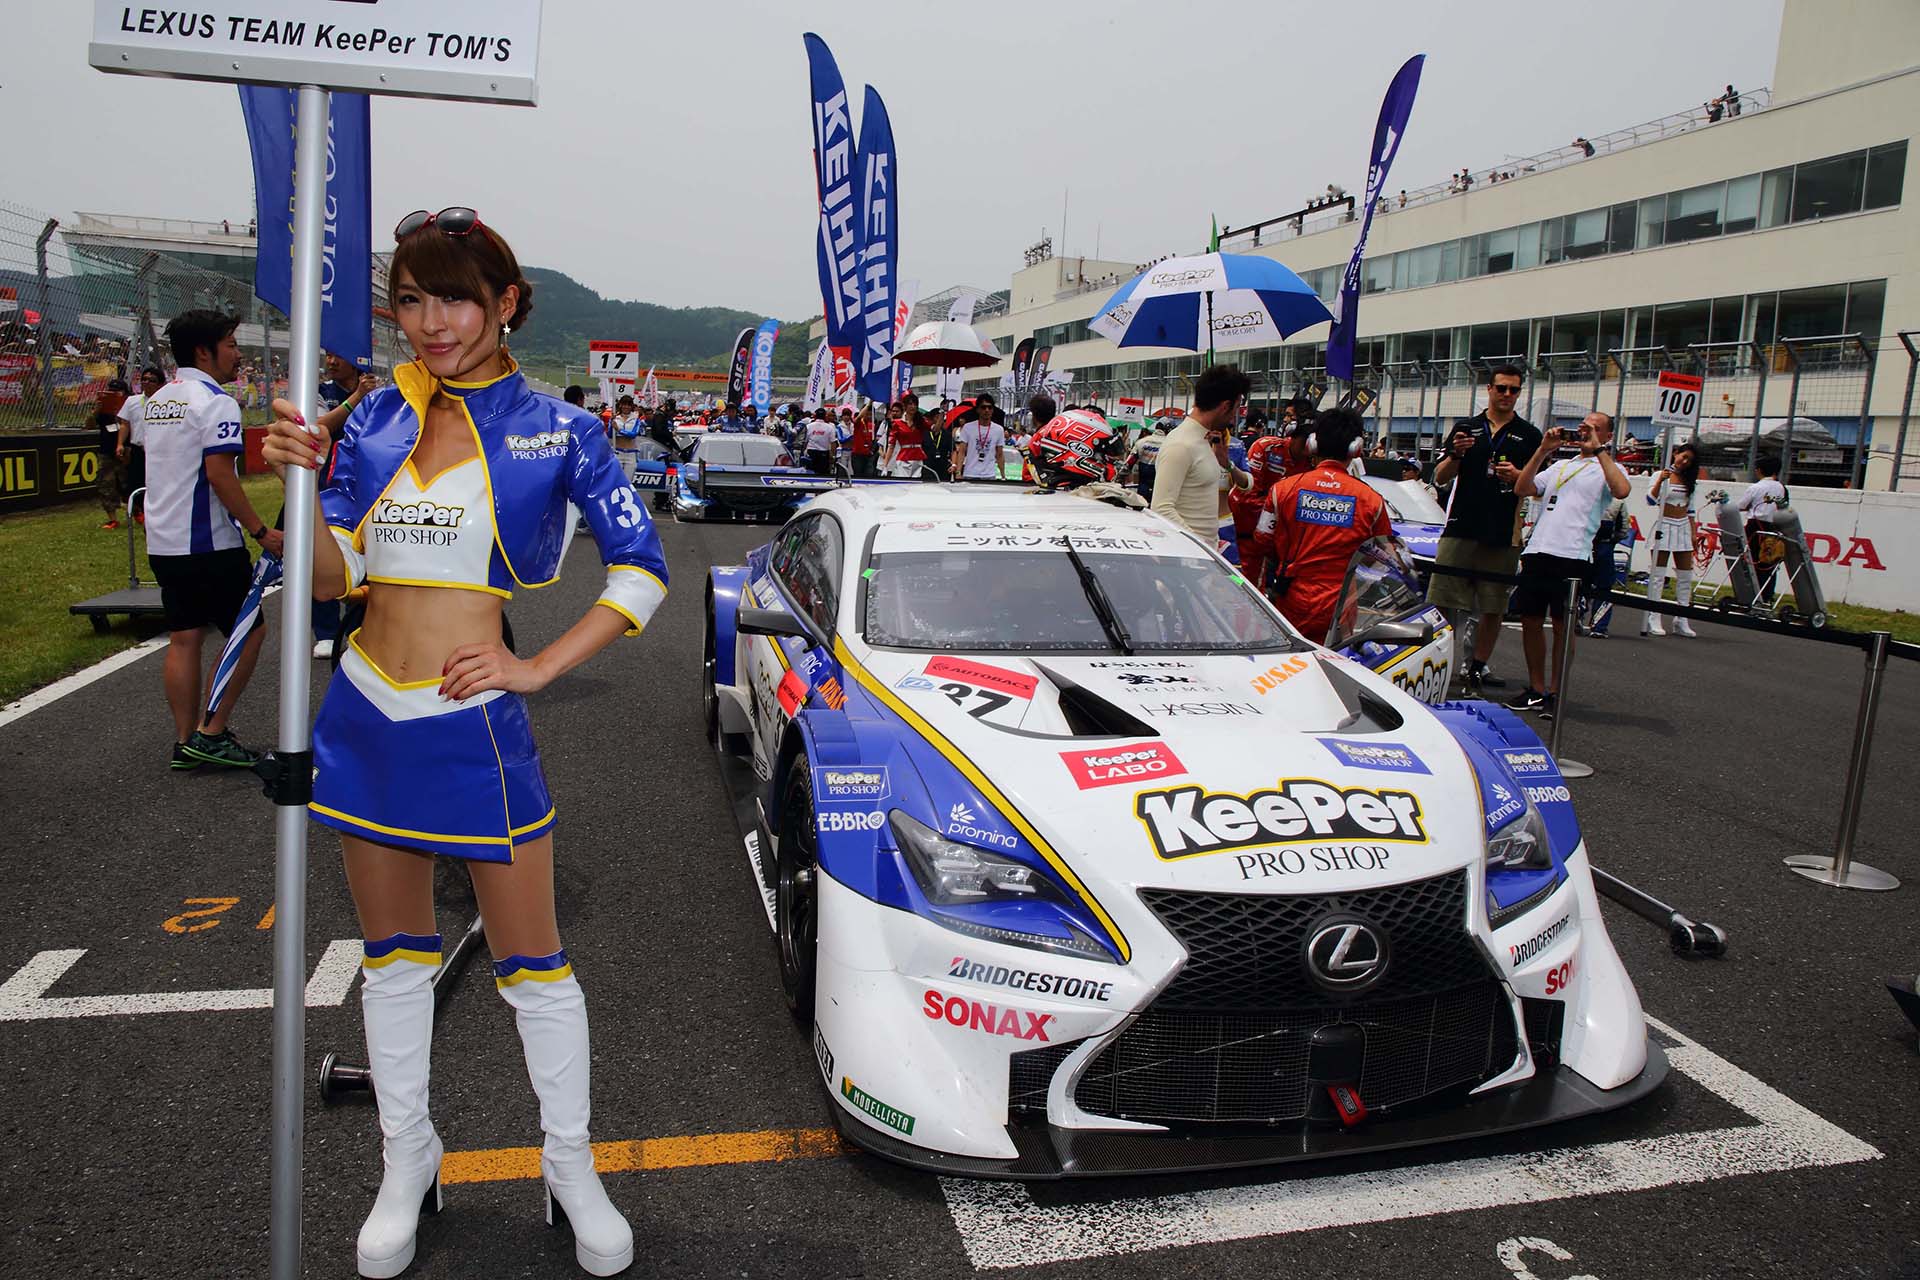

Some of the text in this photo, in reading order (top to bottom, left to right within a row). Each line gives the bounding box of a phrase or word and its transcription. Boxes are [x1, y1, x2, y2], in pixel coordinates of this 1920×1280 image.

[120, 7, 512, 62] LEXUS TEAM KeePer TOM'S
[824, 89, 862, 321] KEIHIN
[864, 152, 892, 373] KEIHIN
[1152, 269, 1214, 284] KeePer
[912, 332, 936, 348] ZENT
[601, 353, 627, 369] 17
[754, 331, 774, 405] KOBELCO
[618, 384, 626, 392] 8
[144, 400, 188, 420] KeePer
[1125, 406, 1136, 414] 24
[1659, 389, 1696, 416] 100
[217, 421, 241, 439] 37
[505, 430, 571, 451] KeePer
[512, 446, 569, 460] PRO SHOP
[0, 456, 34, 492] IL
[610, 485, 653, 530] 3
[1301, 494, 1353, 512] KeePer
[372, 499, 464, 528] KeePer
[1300, 509, 1349, 523] PRO SHOP
[956, 522, 1043, 530] LEXUS
[374, 527, 458, 546] PRO SHOP
[949, 666, 1031, 691] AUTOBACS
[1083, 749, 1159, 768] KeePer
[1334, 742, 1408, 759] KeePer
[1504, 753, 1546, 764] KeePer
[1088, 760, 1168, 781] LABO
[1379, 757, 1413, 767] SHOP
[825, 772, 880, 785] KeePer
[829, 785, 880, 795] PRO SHOP
[817, 811, 886, 831] EBBRO
[1140, 780, 1428, 856] KeePer
[948, 821, 1018, 849] promina
[1237, 846, 1391, 880] PRO SHOP
[1509, 914, 1569, 967] BRIDGESTONE
[947, 955, 1114, 1001] BRIDGESTONE
[922, 990, 1053, 1042] SONAX
[853, 1090, 909, 1131] MODELLISTA
